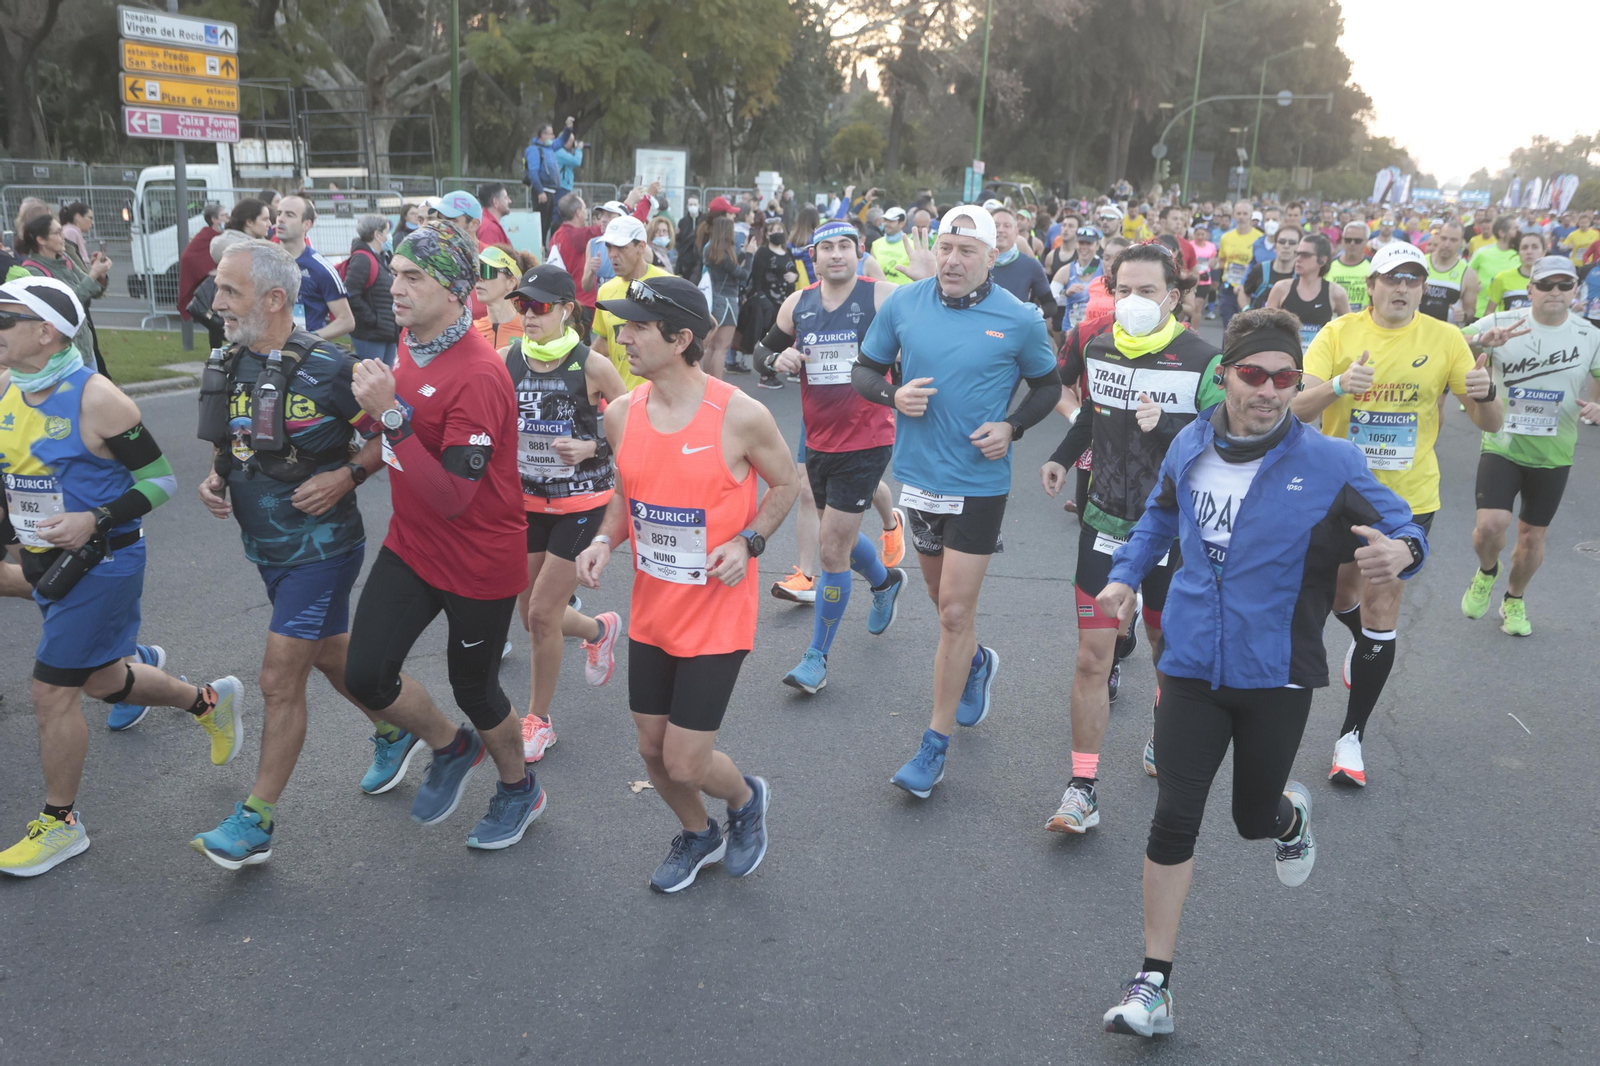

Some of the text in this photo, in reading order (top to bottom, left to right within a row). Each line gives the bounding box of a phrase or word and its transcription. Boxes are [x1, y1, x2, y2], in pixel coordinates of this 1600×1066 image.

[126, 22, 157, 36] Virgen
[160, 28, 175, 37] del
[163, 51, 189, 62] Prado
[128, 58, 146, 67] San
[162, 93, 236, 108] Plaza de Armas
[178, 115, 237, 128] Caixa Forum
[176, 126, 237, 139] Torre Sevilla
[818, 334, 851, 343] ZURICH
[820, 351, 839, 360] 7730
[1094, 368, 1128, 386] TRAIL
[1092, 382, 1178, 405] TURDETANIA
[1526, 392, 1559, 400] ZURICH
[1525, 406, 1545, 414] 9962
[1372, 414, 1410, 424] ZURICH
[526, 423, 564, 433] ZURICH
[1368, 433, 1397, 443] 10507
[528, 441, 550, 451] 8881
[1365, 447, 1397, 456] VALERIO
[526, 455, 556, 464] SANDRA
[16, 478, 53, 490] ZURICH
[20, 501, 40, 513] 9062
[649, 509, 695, 523] ZURICH
[651, 532, 677, 547] 8879
[653, 551, 676, 564] NUNO
